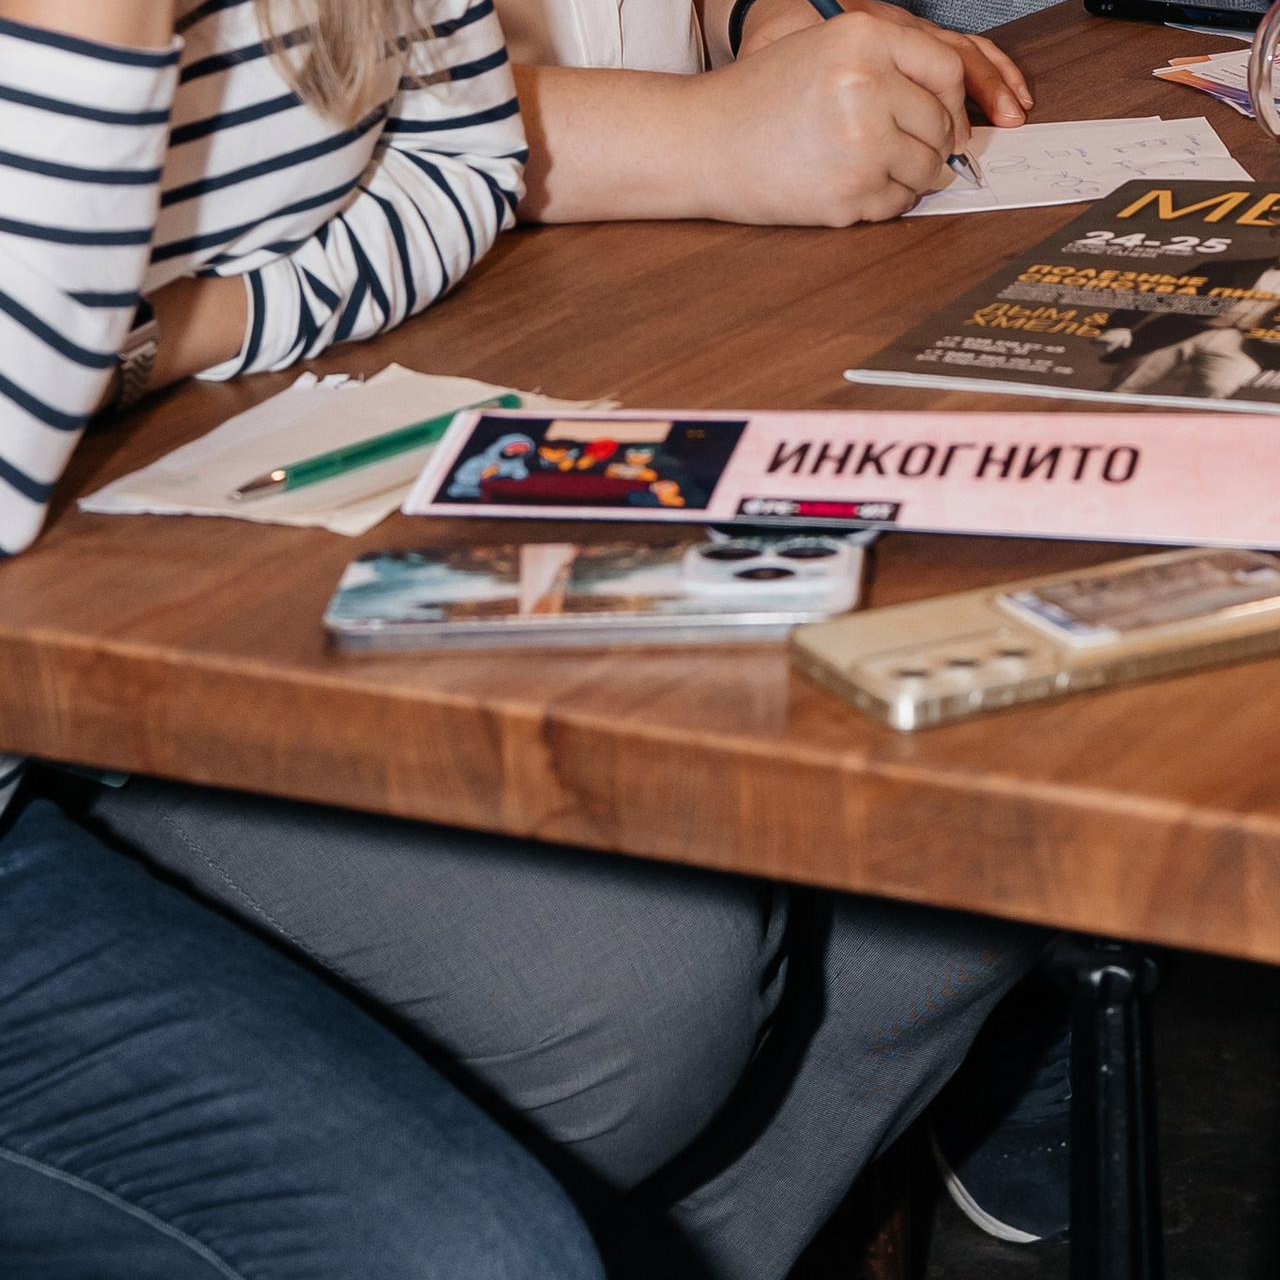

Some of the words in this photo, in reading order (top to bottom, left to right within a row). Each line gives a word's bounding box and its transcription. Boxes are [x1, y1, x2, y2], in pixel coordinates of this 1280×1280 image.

[1075, 230, 1232, 253] 24-25
[1017, 273, 1201, 296] СВОЙСТВА
[1027, 265, 1208, 287] ПОЛЕЗНЫЕ
[976, 302, 1078, 321] ДЫМ
[964, 311, 1103, 337] ХМЕЛЬ
[767, 441, 1140, 483] ИНКОГНИТО
